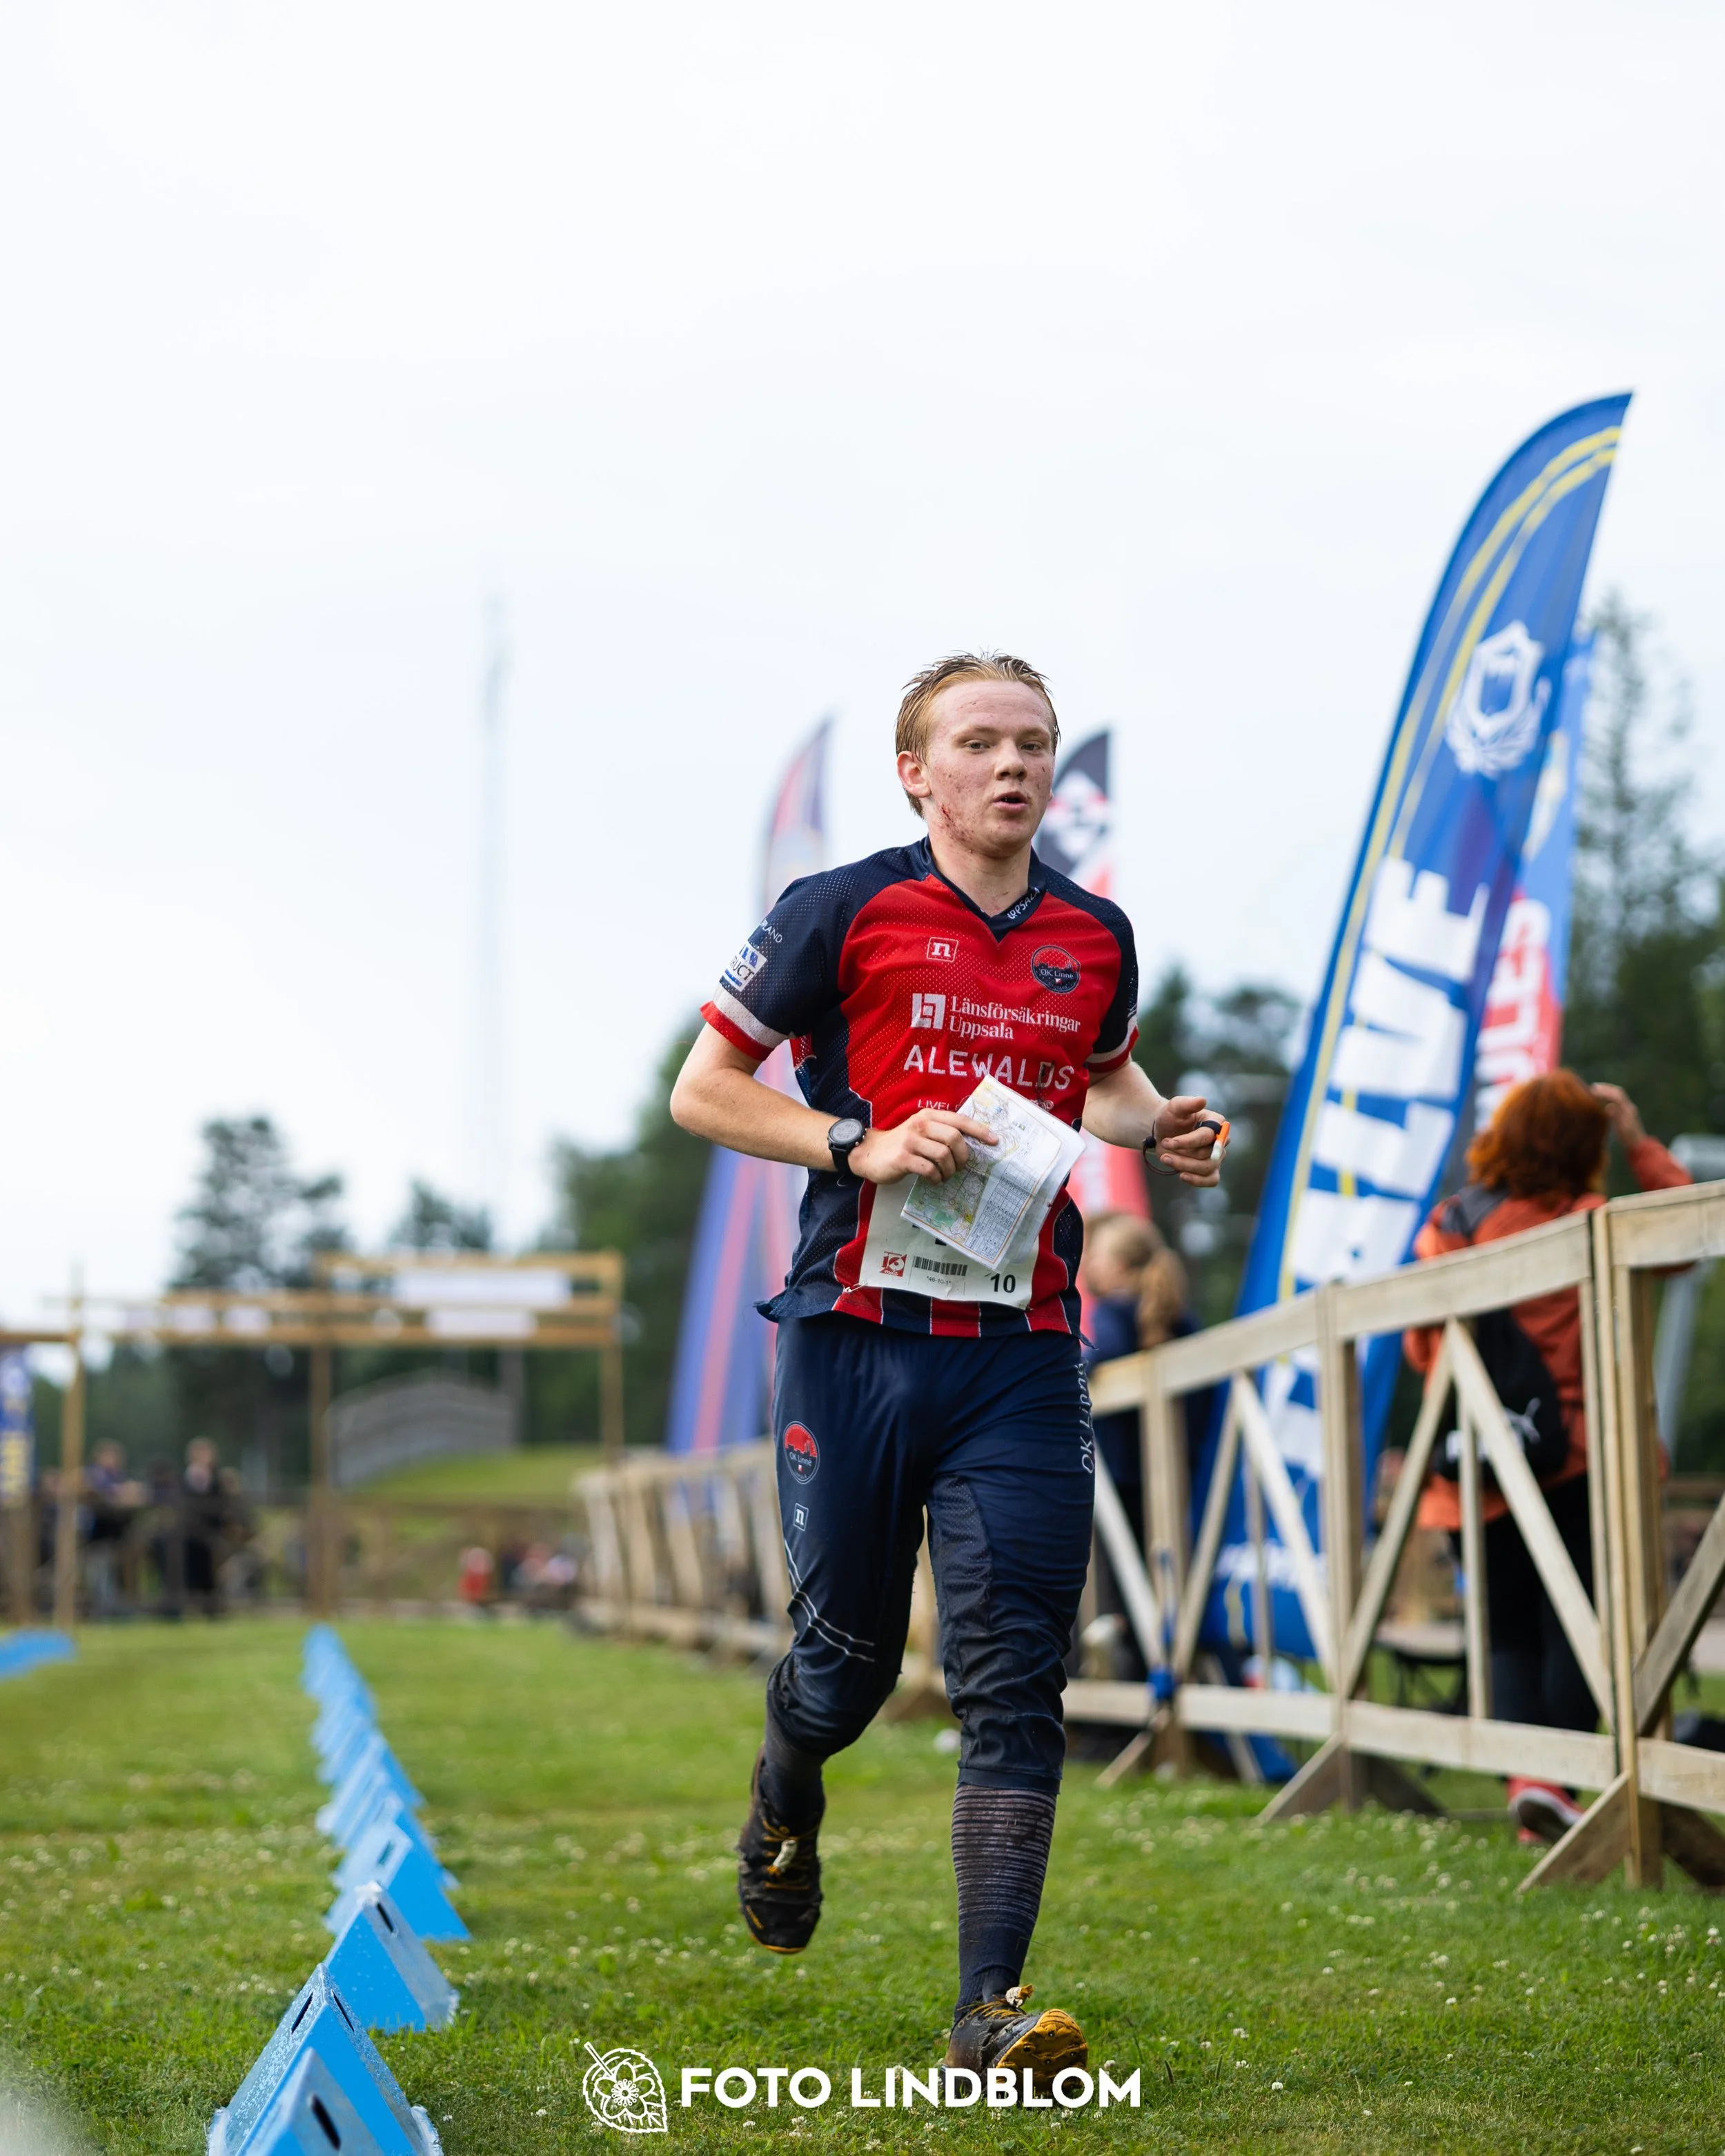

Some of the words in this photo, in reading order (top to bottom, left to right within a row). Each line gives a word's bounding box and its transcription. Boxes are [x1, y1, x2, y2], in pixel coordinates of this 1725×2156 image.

[729, 955, 755, 980] RUCT
[1040, 968, 1054, 978] OK
[949, 1014, 1015, 1040] Uppsala
[950, 996, 1081, 1033] Länsförsäkringar
[903, 1044, 1075, 1091] ALEWALDS
[989, 1273, 1016, 1293] 10
[1074, 1362, 1093, 1428] Linné
[789, 1452, 798, 1463] OK
[798, 1453, 813, 1467] Linné
[1079, 1436, 1094, 1474] OK
